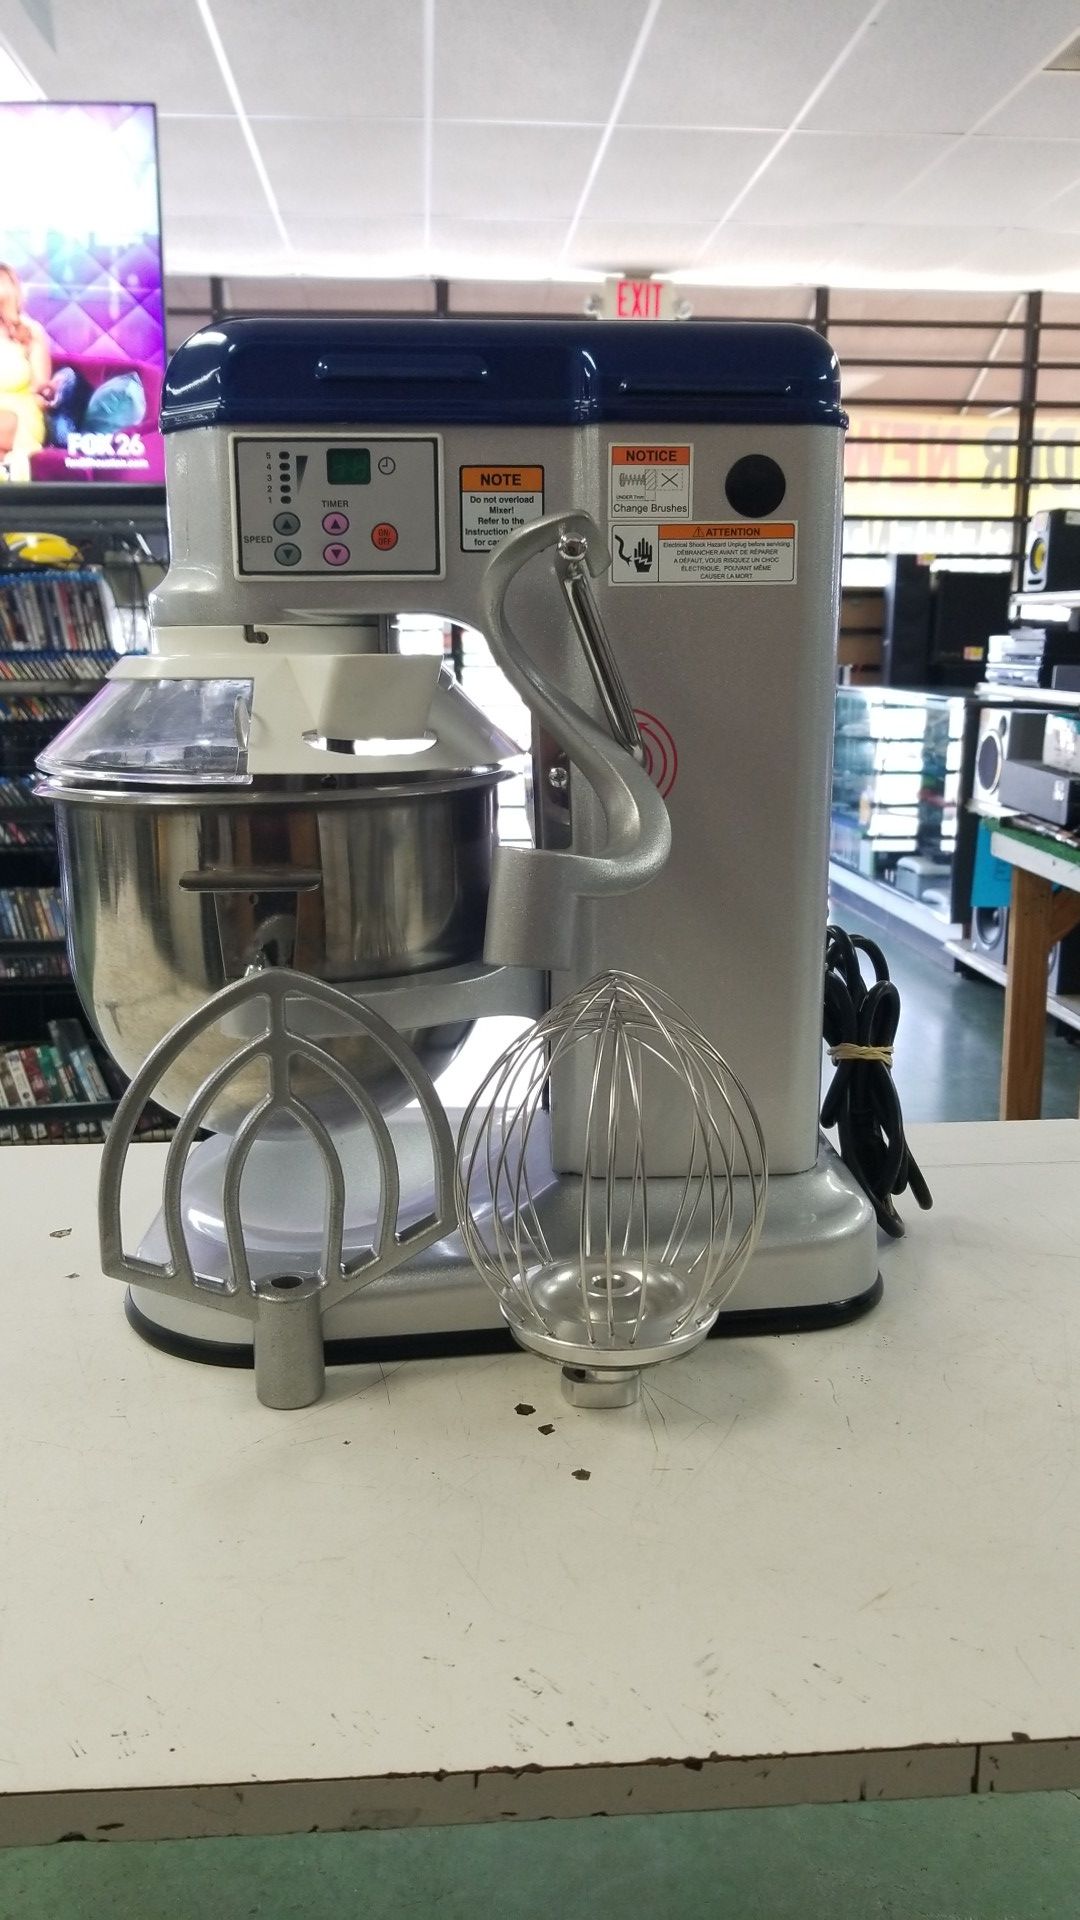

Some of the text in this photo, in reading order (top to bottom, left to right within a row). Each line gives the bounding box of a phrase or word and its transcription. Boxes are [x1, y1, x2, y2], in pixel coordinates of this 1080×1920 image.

[616, 281, 664, 318] EXIT
[67, 432, 146, 457] FOX 26
[266, 452, 271, 460] 5
[626, 450, 677, 462] NOTICE
[266, 463, 272, 471] 4
[480, 473, 522, 486] NOTE
[321, 500, 349, 508] TIMER
[470, 496, 535, 504] Do not overload
[489, 506, 514, 514] Mixer!
[613, 503, 688, 515] Change Brushes
[478, 517, 525, 525] Refer to the
[465, 527, 508, 536] Instruction
[706, 527, 761, 537] ATTENTION
[243, 535, 273, 544] SPEED
[378, 537, 392, 545] OFF
[474, 538, 485, 546] for
[728, 541, 747, 549] Unplug
